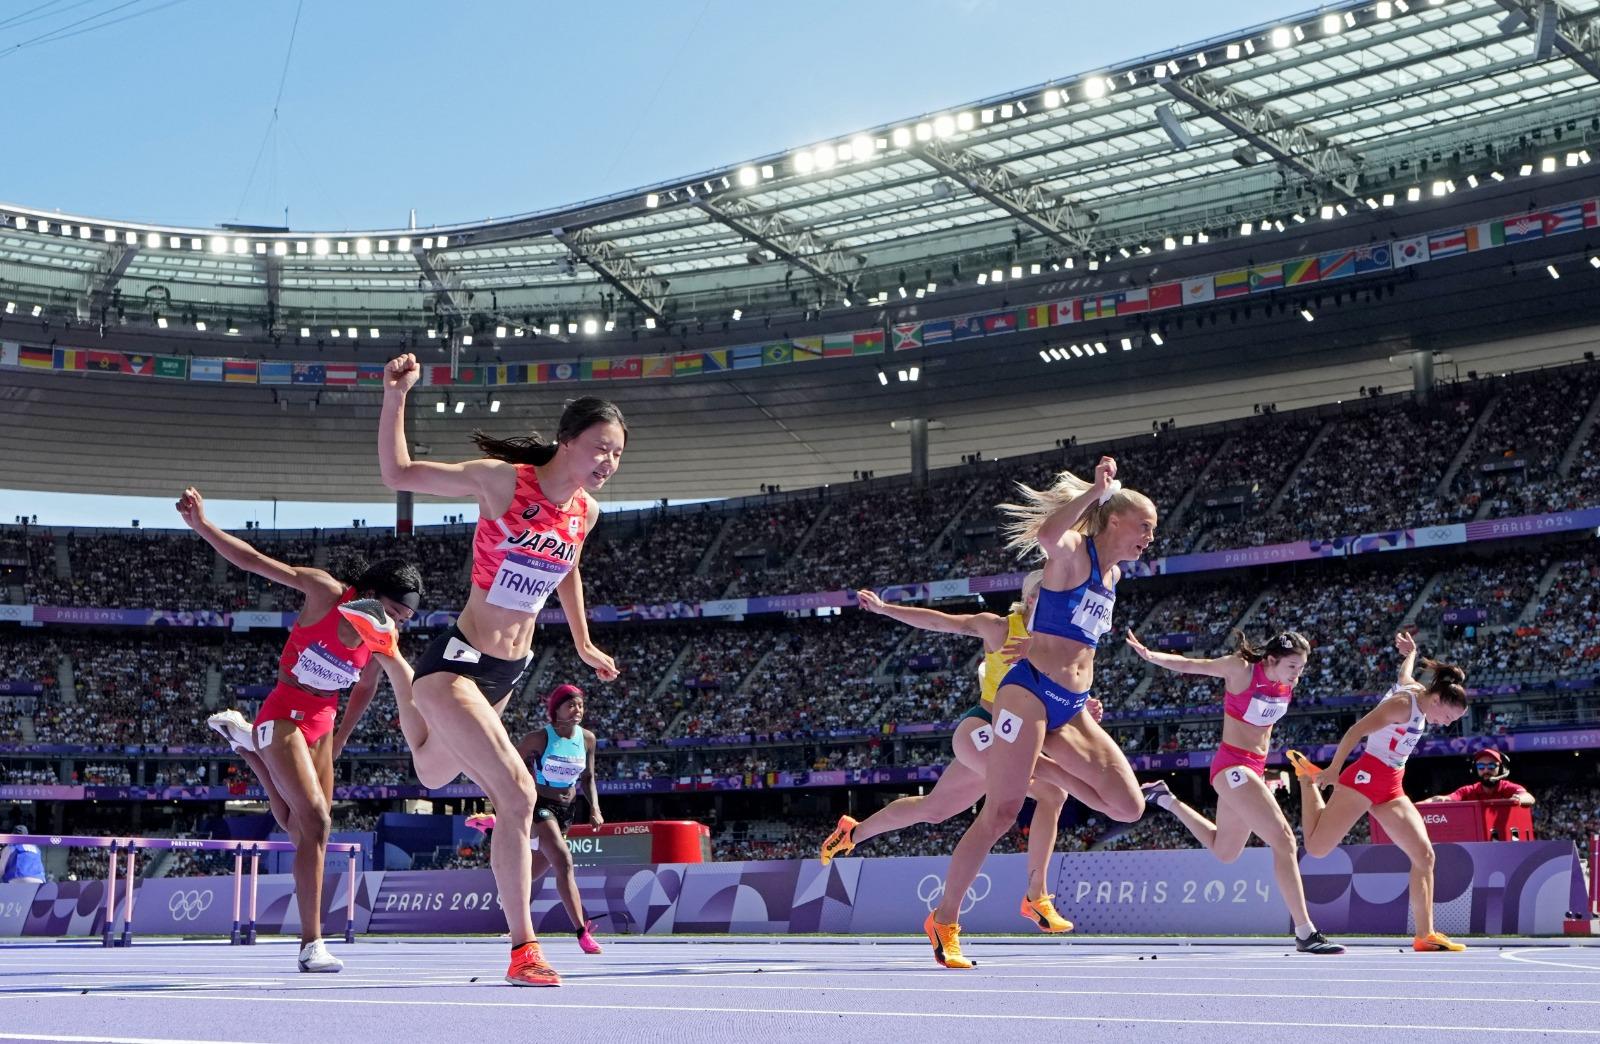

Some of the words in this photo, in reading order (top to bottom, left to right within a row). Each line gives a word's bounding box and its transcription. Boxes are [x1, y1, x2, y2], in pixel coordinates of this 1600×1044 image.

[1492, 521, 1532, 534] PARIS
[1537, 517, 1573, 529] 2024
[507, 529, 576, 561] JAPAN
[1225, 551, 1259, 563] PARIS
[1263, 549, 1295, 560] 2024
[527, 558, 545, 568] PARIS
[990, 576, 1020, 588] PARIS
[768, 598, 797, 609] PARIS
[57, 610, 90, 620] PARIS
[94, 611, 124, 620] 2024
[541, 611, 564, 620] PARI
[1045, 690, 1067, 706] CRAFT
[1261, 708, 1277, 718] WU
[1001, 718, 1012, 734] 6
[260, 726, 267, 741] 7
[978, 730, 990, 743] 5
[1533, 735, 1568, 746] PARIS
[1231, 771, 1241, 783] 3
[602, 782, 627, 790] PARIS
[629, 780, 652, 790] 2024
[623, 825, 650, 834] OMEGA
[595, 838, 603, 852] L
[1182, 880, 1270, 903] 2024
